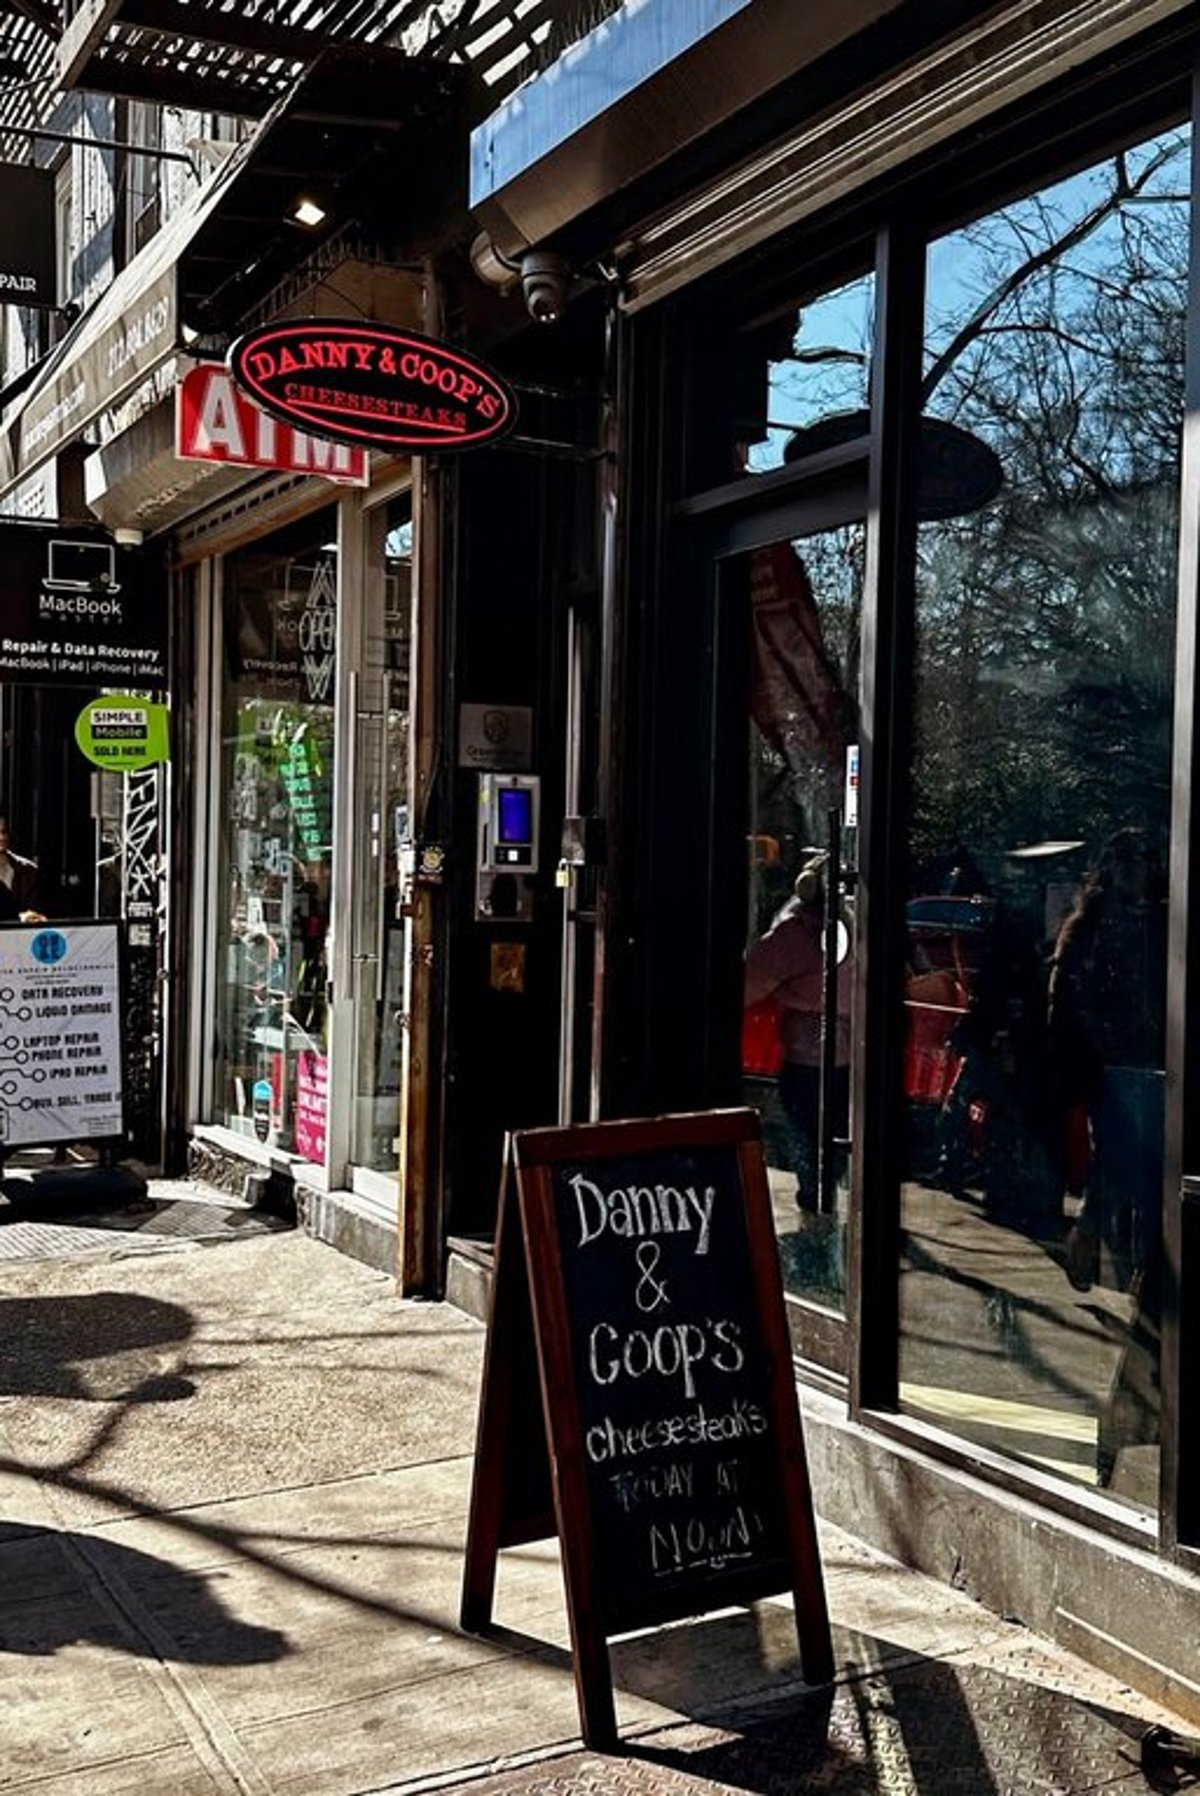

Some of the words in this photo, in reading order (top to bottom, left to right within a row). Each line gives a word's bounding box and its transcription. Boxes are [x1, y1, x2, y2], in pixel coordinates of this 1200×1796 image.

[0, 274, 37, 291] PAIR
[284, 382, 467, 427] CHEESESTEAKS
[39, 594, 122, 615] MacBook
[2, 638, 48, 654] Repair
[51, 642, 61, 653] &
[65, 642, 96, 655] Data
[98, 644, 159, 662] Recovery
[58, 660, 84, 672] iPad
[91, 662, 131, 675] iPhone
[93, 711, 144, 723] SIMPLE
[95, 726, 143, 738] Mobile
[22, 988, 49, 1001] DATA
[23, 1035, 61, 1048] LAPTOP
[64, 1032, 99, 1045] REPAIR
[67, 1046, 102, 1058] REPAIR
[74, 1064, 107, 1077] REPAIR
[568, 1173, 716, 1255] Danny
[635, 1240, 672, 1312] &
